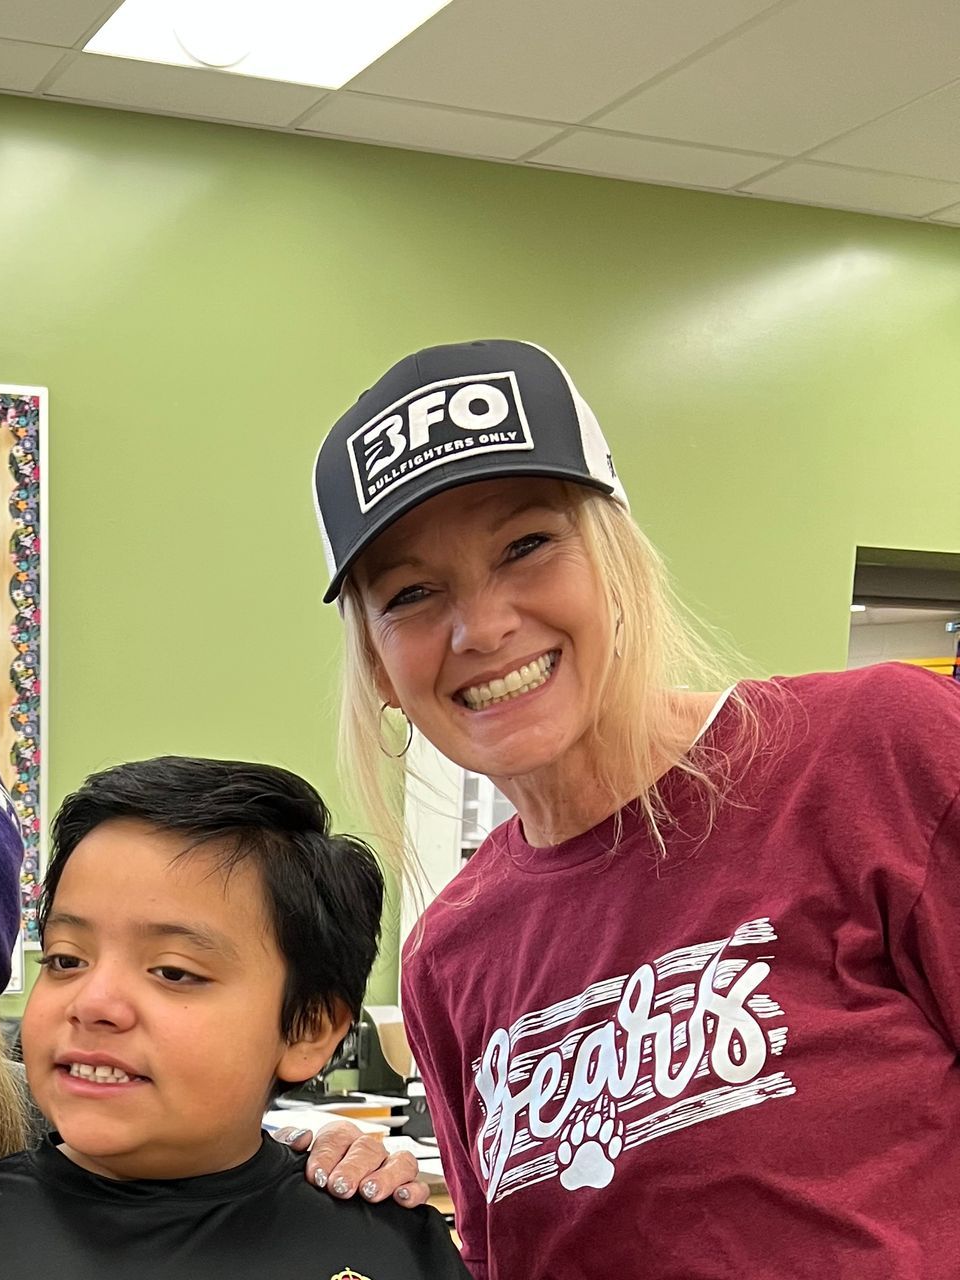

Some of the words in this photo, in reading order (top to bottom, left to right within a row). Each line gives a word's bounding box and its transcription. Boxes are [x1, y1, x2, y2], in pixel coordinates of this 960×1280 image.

[363, 383, 510, 481] BFO
[367, 436, 475, 497] BULLFIGHTERS
[479, 430, 519, 446] ONLY
